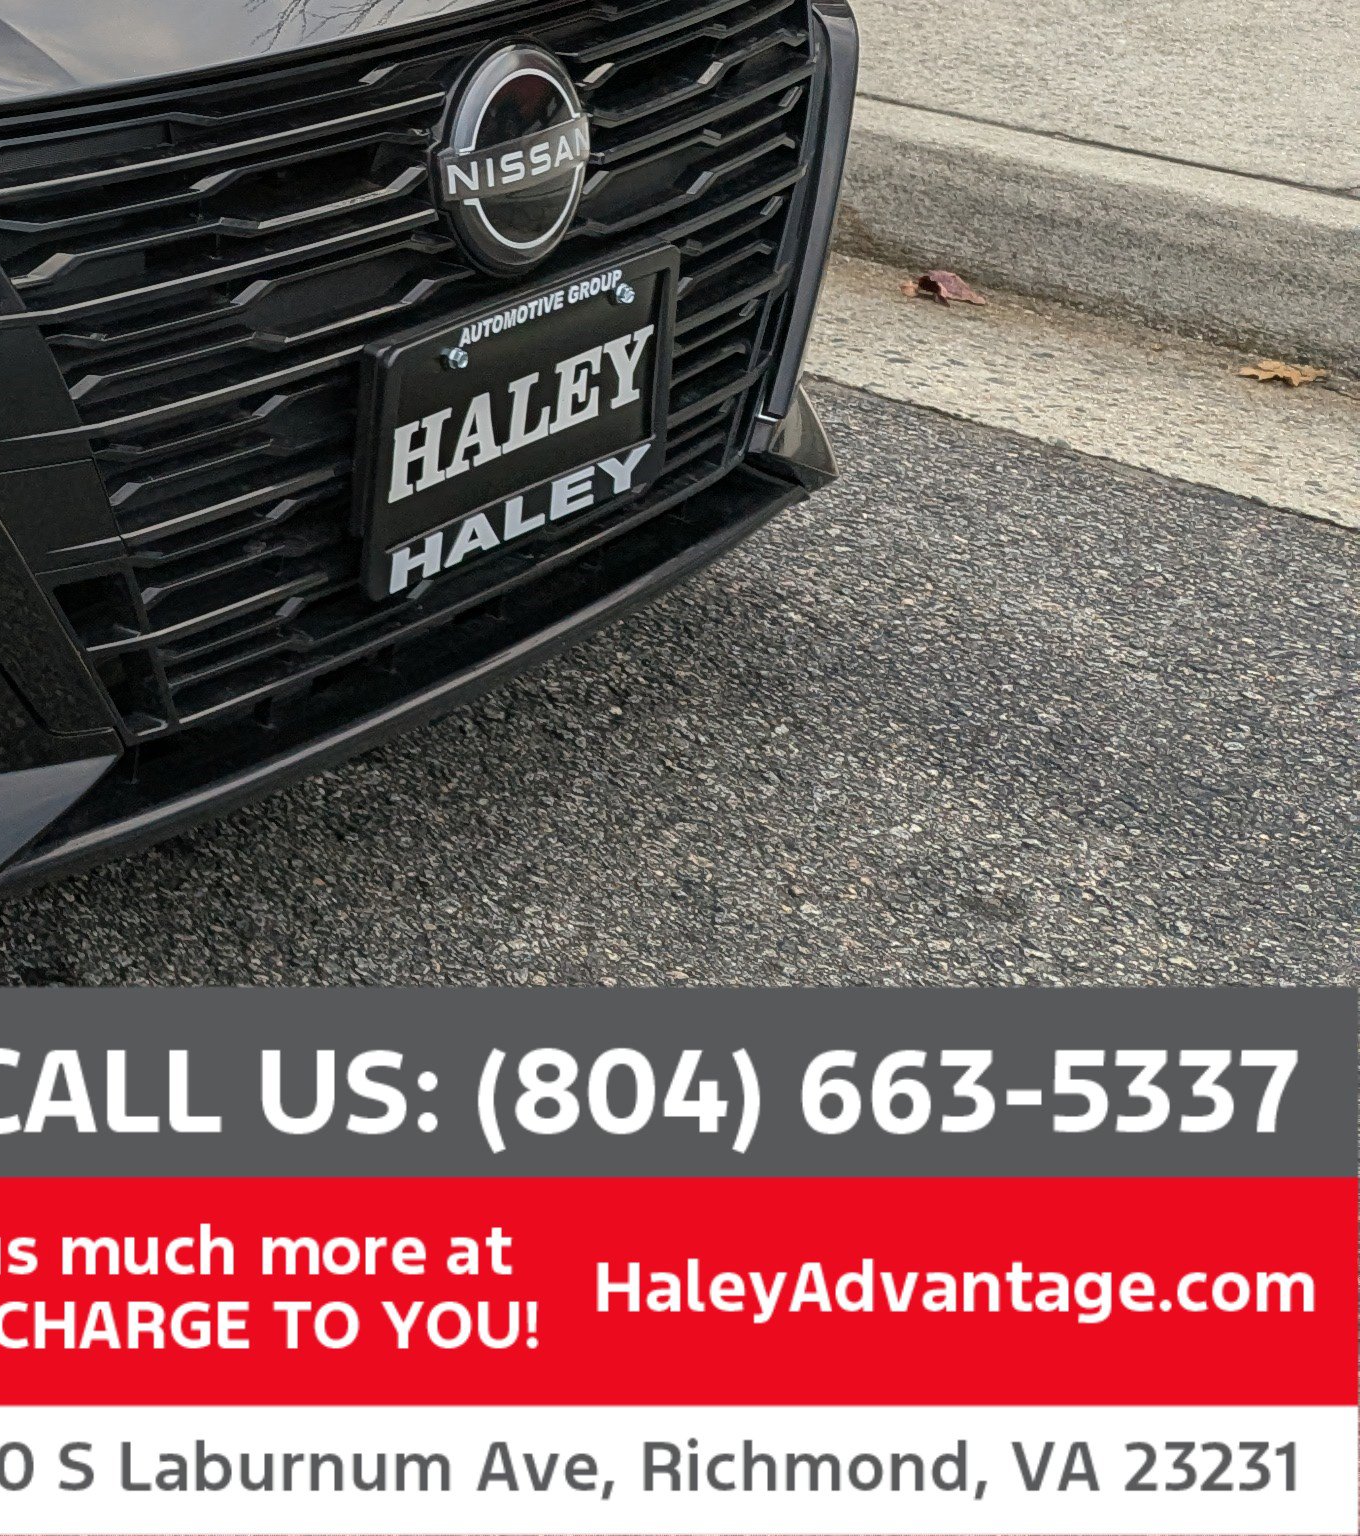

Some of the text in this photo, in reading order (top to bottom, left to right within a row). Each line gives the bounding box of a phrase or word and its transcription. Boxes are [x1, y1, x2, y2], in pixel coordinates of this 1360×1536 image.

[447, 114, 591, 198] NISSAN
[459, 269, 624, 349] AUTOMOTIVE GROUP
[387, 324, 654, 504] HALEY
[388, 443, 652, 595] HALEY
